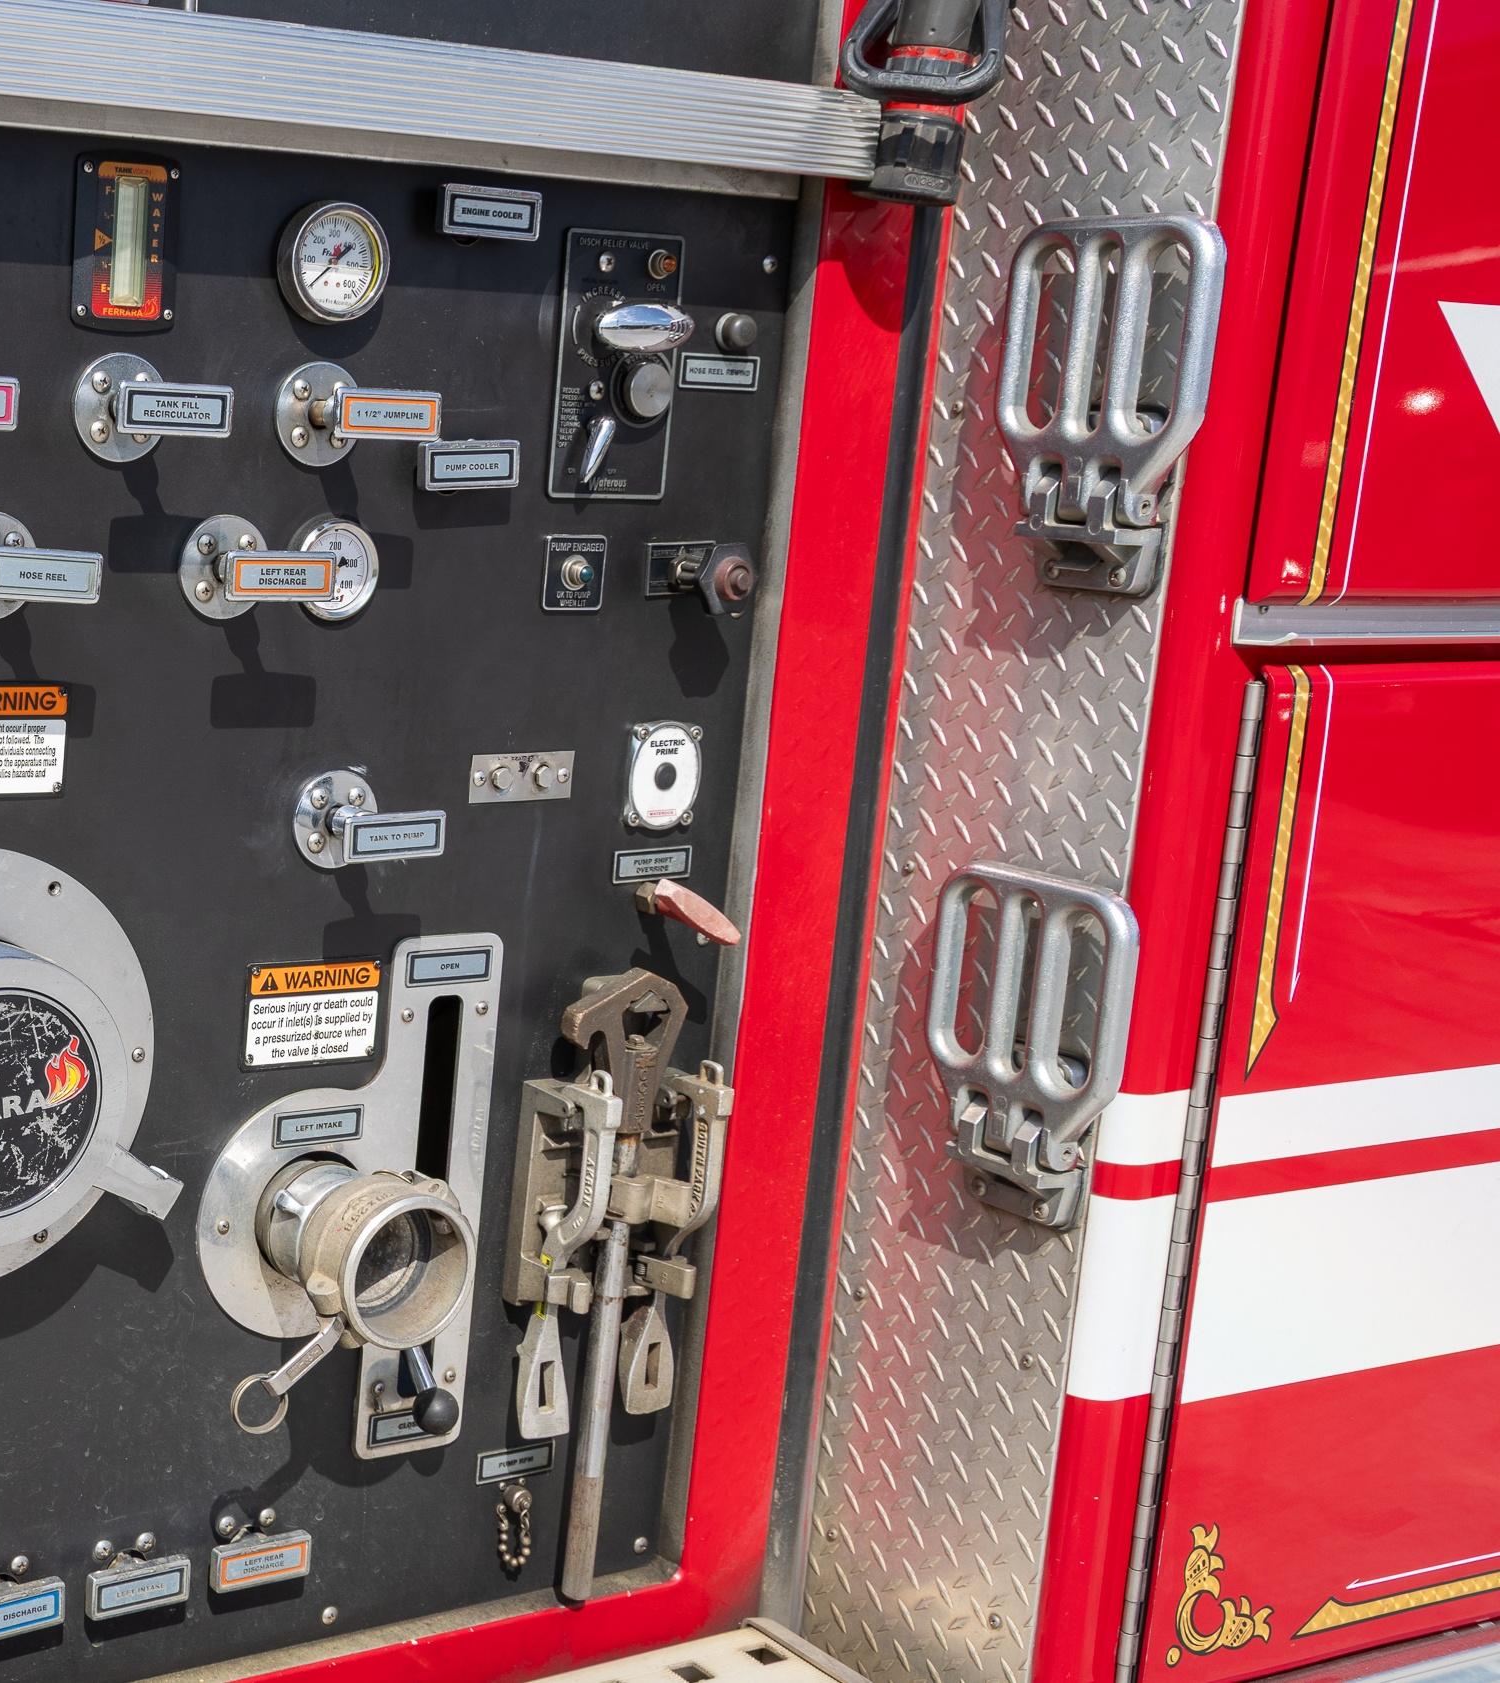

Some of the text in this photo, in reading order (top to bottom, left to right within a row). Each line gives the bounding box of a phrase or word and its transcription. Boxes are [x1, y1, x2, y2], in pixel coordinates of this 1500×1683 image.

[462, 207, 523, 220] ENGINE COOLER
[151, 192, 164, 263] WATER
[602, 238, 627, 248] RELIEF
[628, 240, 650, 250] VALVE
[103, 307, 143, 317] FERRARA
[156, 400, 200, 410] TANK FILL
[143, 410, 211, 419] RECIRCULATOR
[384, 411, 424, 420] JUMPLINE
[445, 463, 499, 472] PUMP COOLER
[551, 542, 604, 552] PUMP ENGAGED
[20, 571, 67, 582] HOSE REEL
[260, 568, 307, 576] LEFT REAR
[258, 578, 307, 586] DISCHARGE
[27, 726, 46, 734] proper
[650, 739, 686, 748] ELECTRIC
[656, 748, 679, 756] PRIME
[369, 832, 425, 842] TANK TO PUMP
[634, 856, 674, 866] PUMP SHIFT
[440, 962, 460, 970] OPEN
[284, 967, 370, 989] WARNING
[253, 1004, 285, 1015] Serious
[288, 1001, 311, 1014] injury
[324, 998, 348, 1010] death
[350, 997, 373, 1007] could
[251, 1011, 373, 1030] occur if inlet(s) is supplied by
[255, 1028, 367, 1046] a pressurized source when
[271, 1042, 349, 1058] the valve is closed
[295, 1121, 343, 1132] LEFT INTAKE
[397, 1421, 418, 1430] CLOS
[244, 1558, 262, 1566] LEFT
[3, 1605, 48, 1621] DISCHARGE
